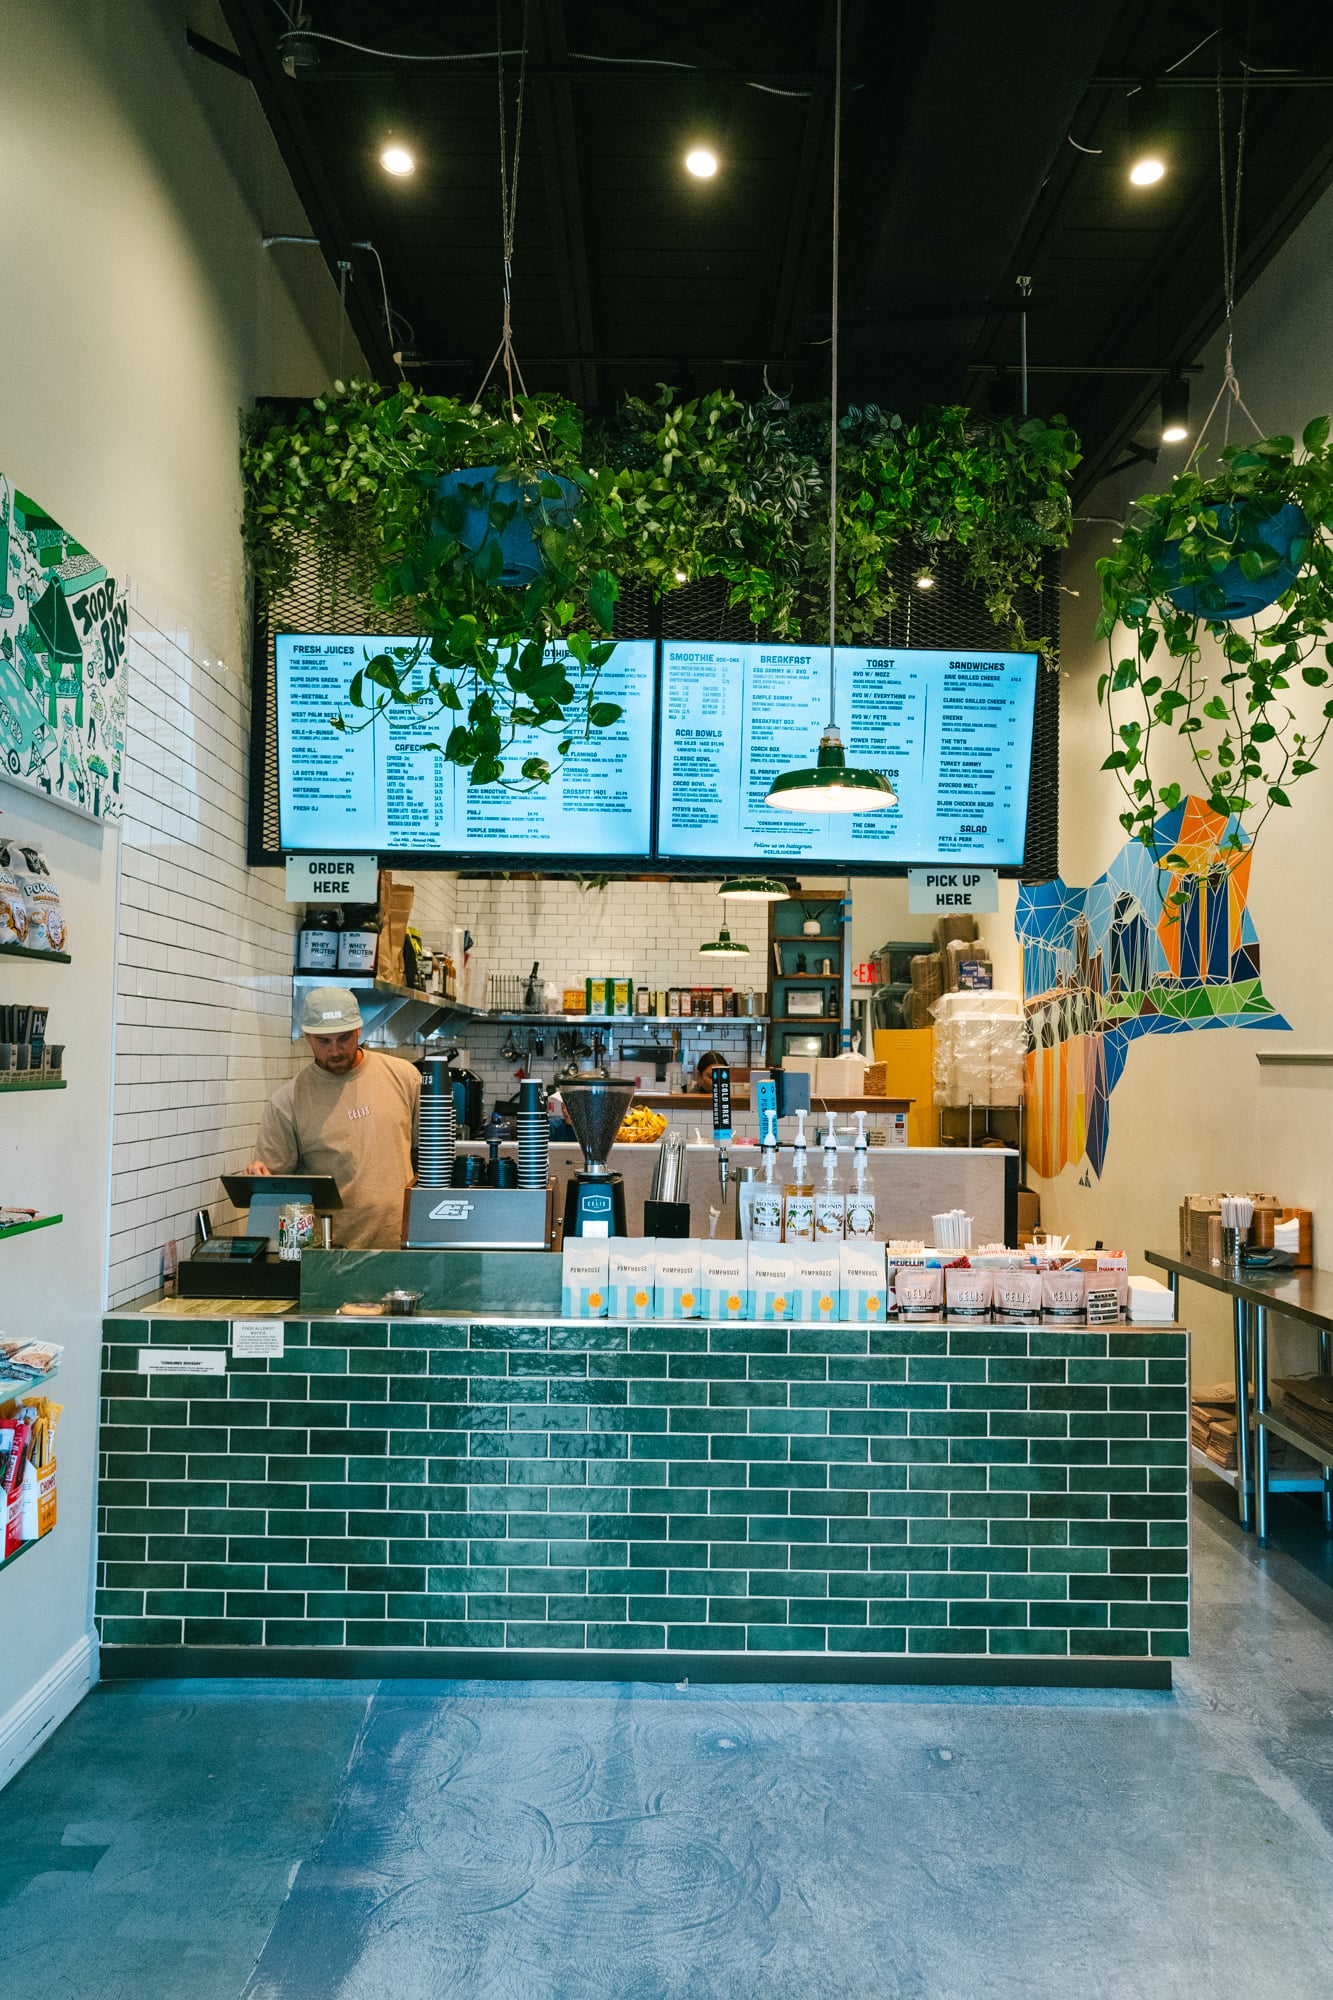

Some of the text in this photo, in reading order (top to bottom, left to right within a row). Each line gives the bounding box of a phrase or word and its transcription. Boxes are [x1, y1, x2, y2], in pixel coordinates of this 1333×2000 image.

[72, 578, 115, 636] TODO
[100, 599, 128, 679] BIEN
[293, 645, 354, 655] FRESH JUICES
[669, 653, 714, 662] SMOOTHIE
[760, 656, 811, 665] BREAKFAST
[866, 660, 895, 668] TOAST
[949, 661, 1005, 671] SANDWICHES
[675, 729, 693, 737] ACAI
[960, 825, 987, 833] SALAD
[786, 842, 812, 850] Instagram
[309, 862, 354, 874] ORDER
[926, 875, 980, 887] PICK UP
[313, 881, 350, 893] HERE
[936, 894, 972, 905] HERE
[721, 1083, 729, 1102] COLD
[347, 1106, 370, 1120] CELIS
[755, 1270, 786, 1278] PUMPHOUSE
[848, 1269, 878, 1277] PUMPHOUSE
[905, 1288, 932, 1299] CELIS
[958, 1291, 984, 1302] CELIS
[1004, 1291, 1030, 1303] CELIS
[1053, 1291, 1079, 1302] CELIS
